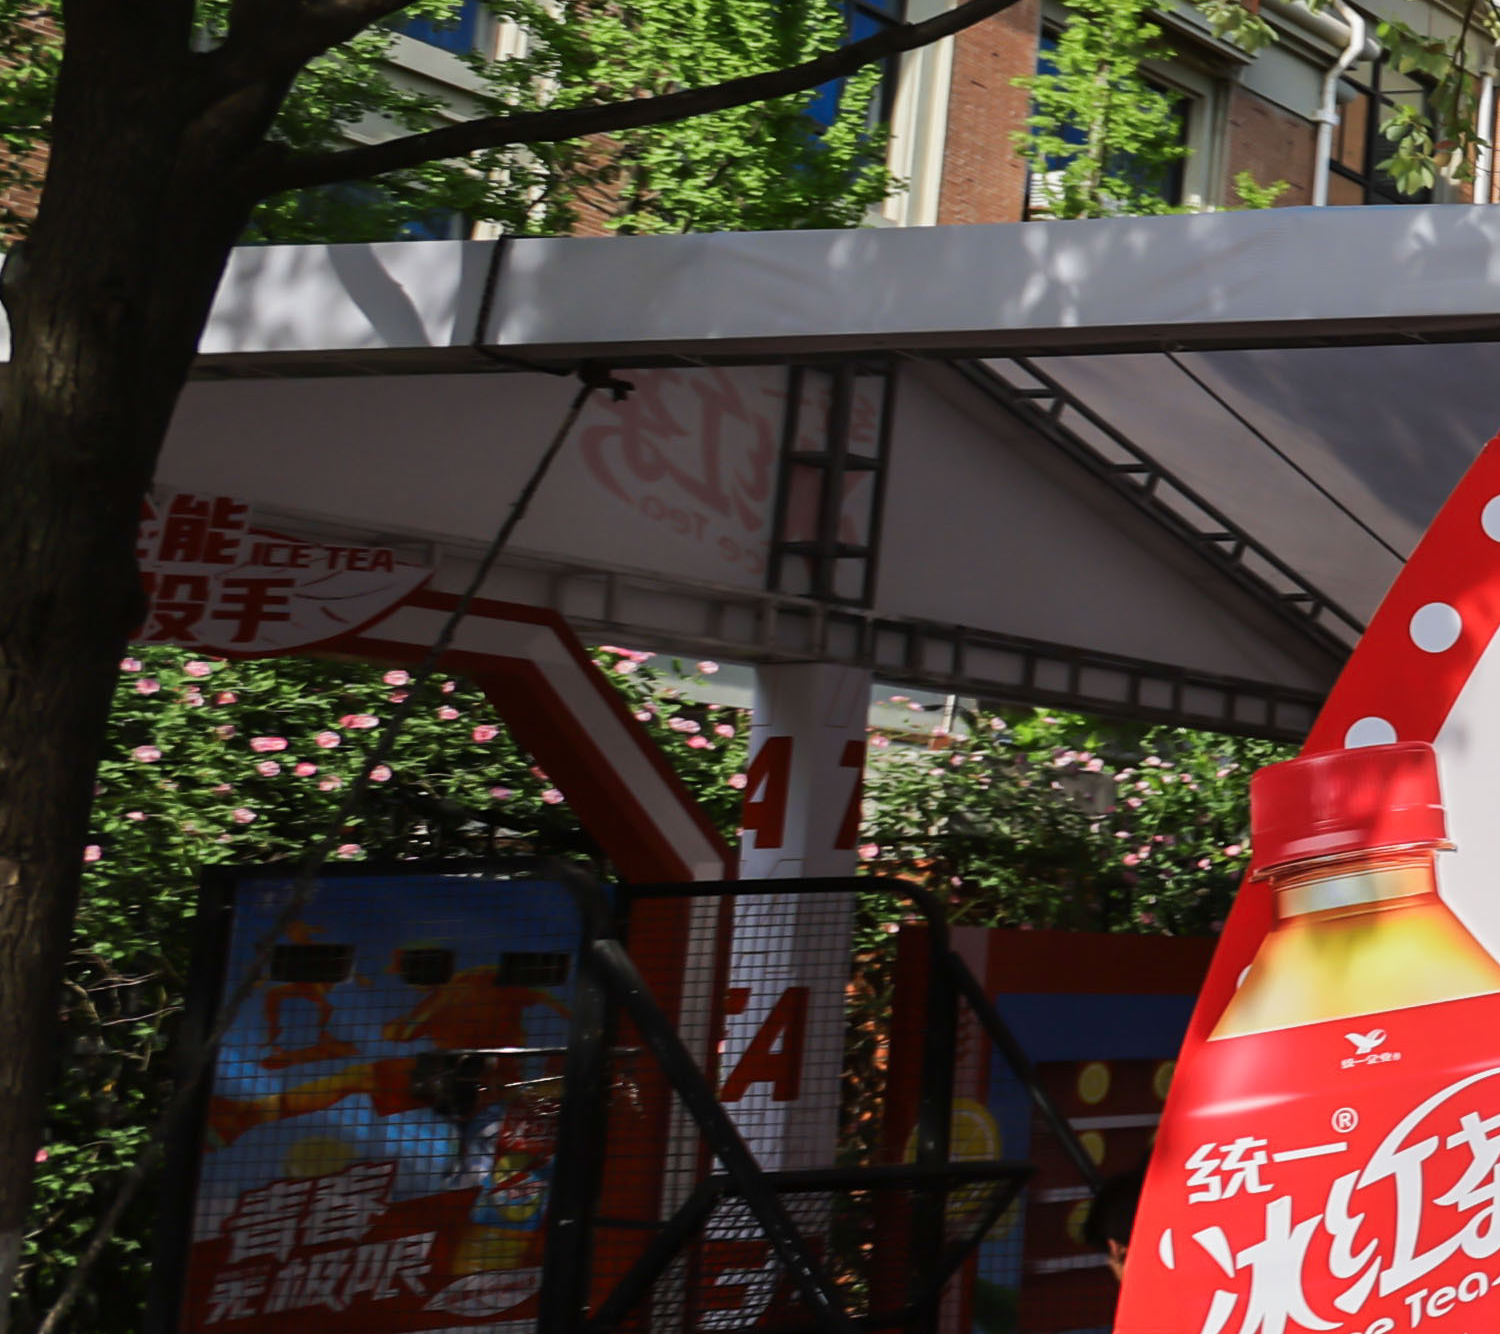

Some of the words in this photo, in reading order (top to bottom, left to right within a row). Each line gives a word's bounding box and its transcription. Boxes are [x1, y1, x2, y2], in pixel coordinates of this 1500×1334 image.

[250, 540, 313, 570] ICE
[325, 543, 395, 575] TEA
[1184, 1135, 1348, 1205] 统一
[222, 1162, 396, 1265] 青春
[204, 1230, 438, 1326] 无极限
[1405, 1270, 1490, 1329] Tea
